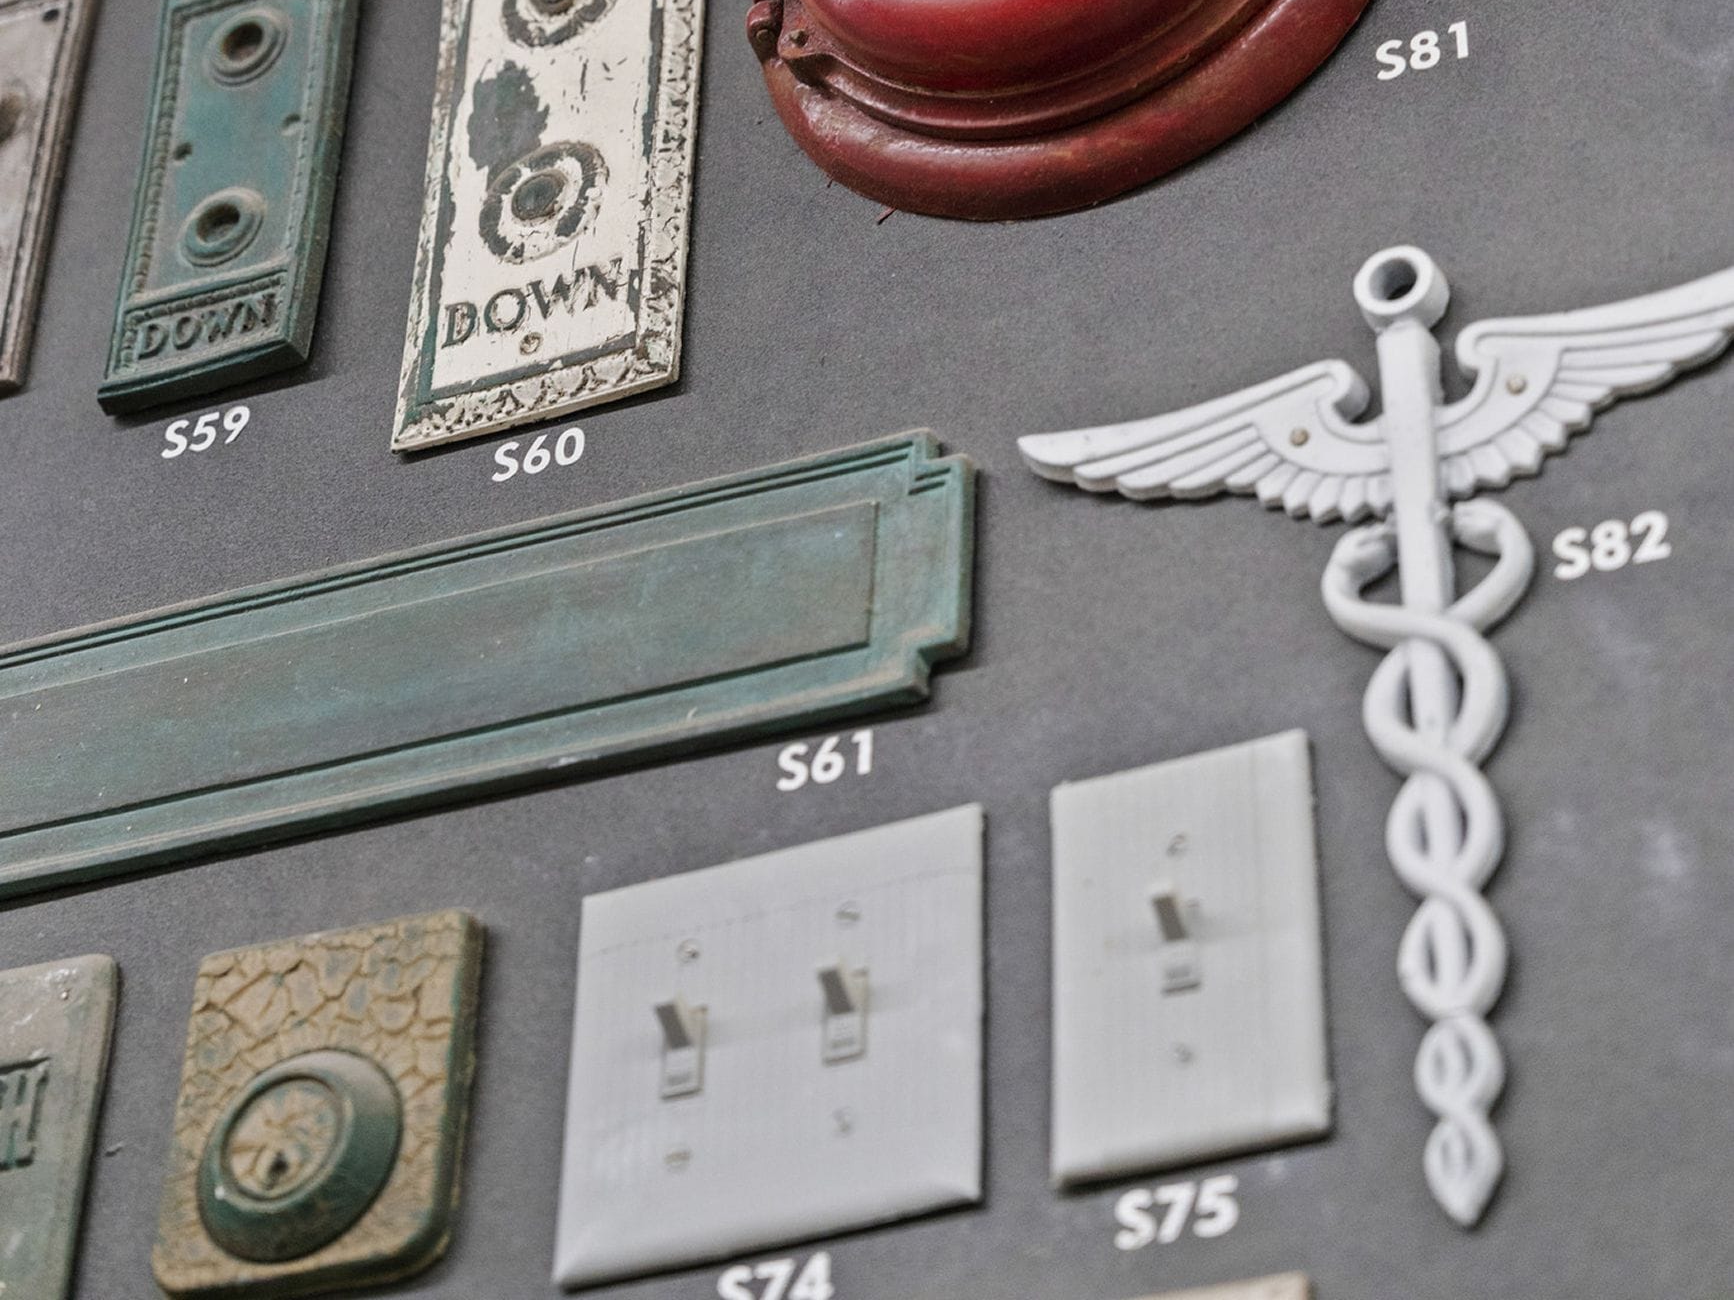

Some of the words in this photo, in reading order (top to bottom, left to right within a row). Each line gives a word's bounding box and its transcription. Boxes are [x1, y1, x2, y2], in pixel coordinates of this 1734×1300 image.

[1374, 19, 1471, 81] S81
[134, 292, 277, 361] DOWN
[440, 257, 625, 350] DOWN
[160, 404, 251, 460] S59
[490, 426, 586, 483] S60
[1552, 510, 1672, 580] S82
[776, 728, 873, 792] S61
[1114, 1174, 1239, 1251] S75
[717, 1251, 834, 1300] S74
